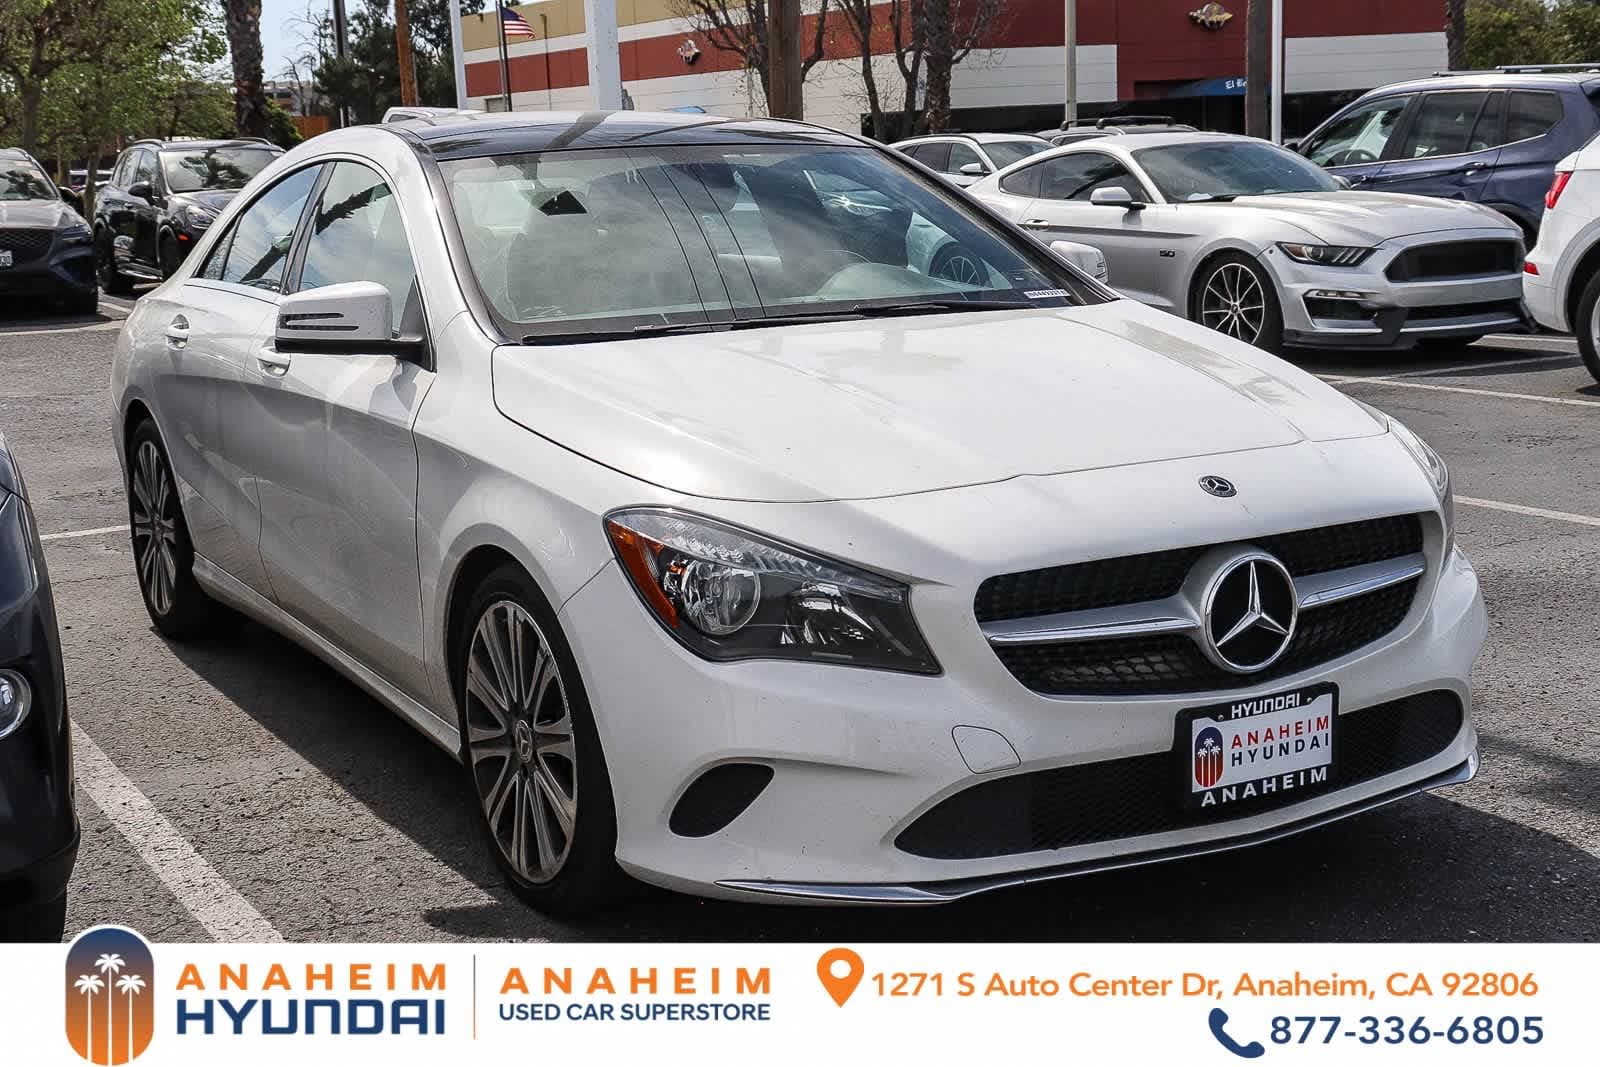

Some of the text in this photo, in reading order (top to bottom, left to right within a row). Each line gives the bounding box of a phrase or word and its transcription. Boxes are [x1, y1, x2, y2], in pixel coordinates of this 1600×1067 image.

[1231, 692, 1300, 719] HYUNDAI
[1231, 715, 1329, 750] ANAHEIM
[1231, 733, 1329, 767] HYUNDAI
[1201, 766, 1328, 808] ANAHEIM
